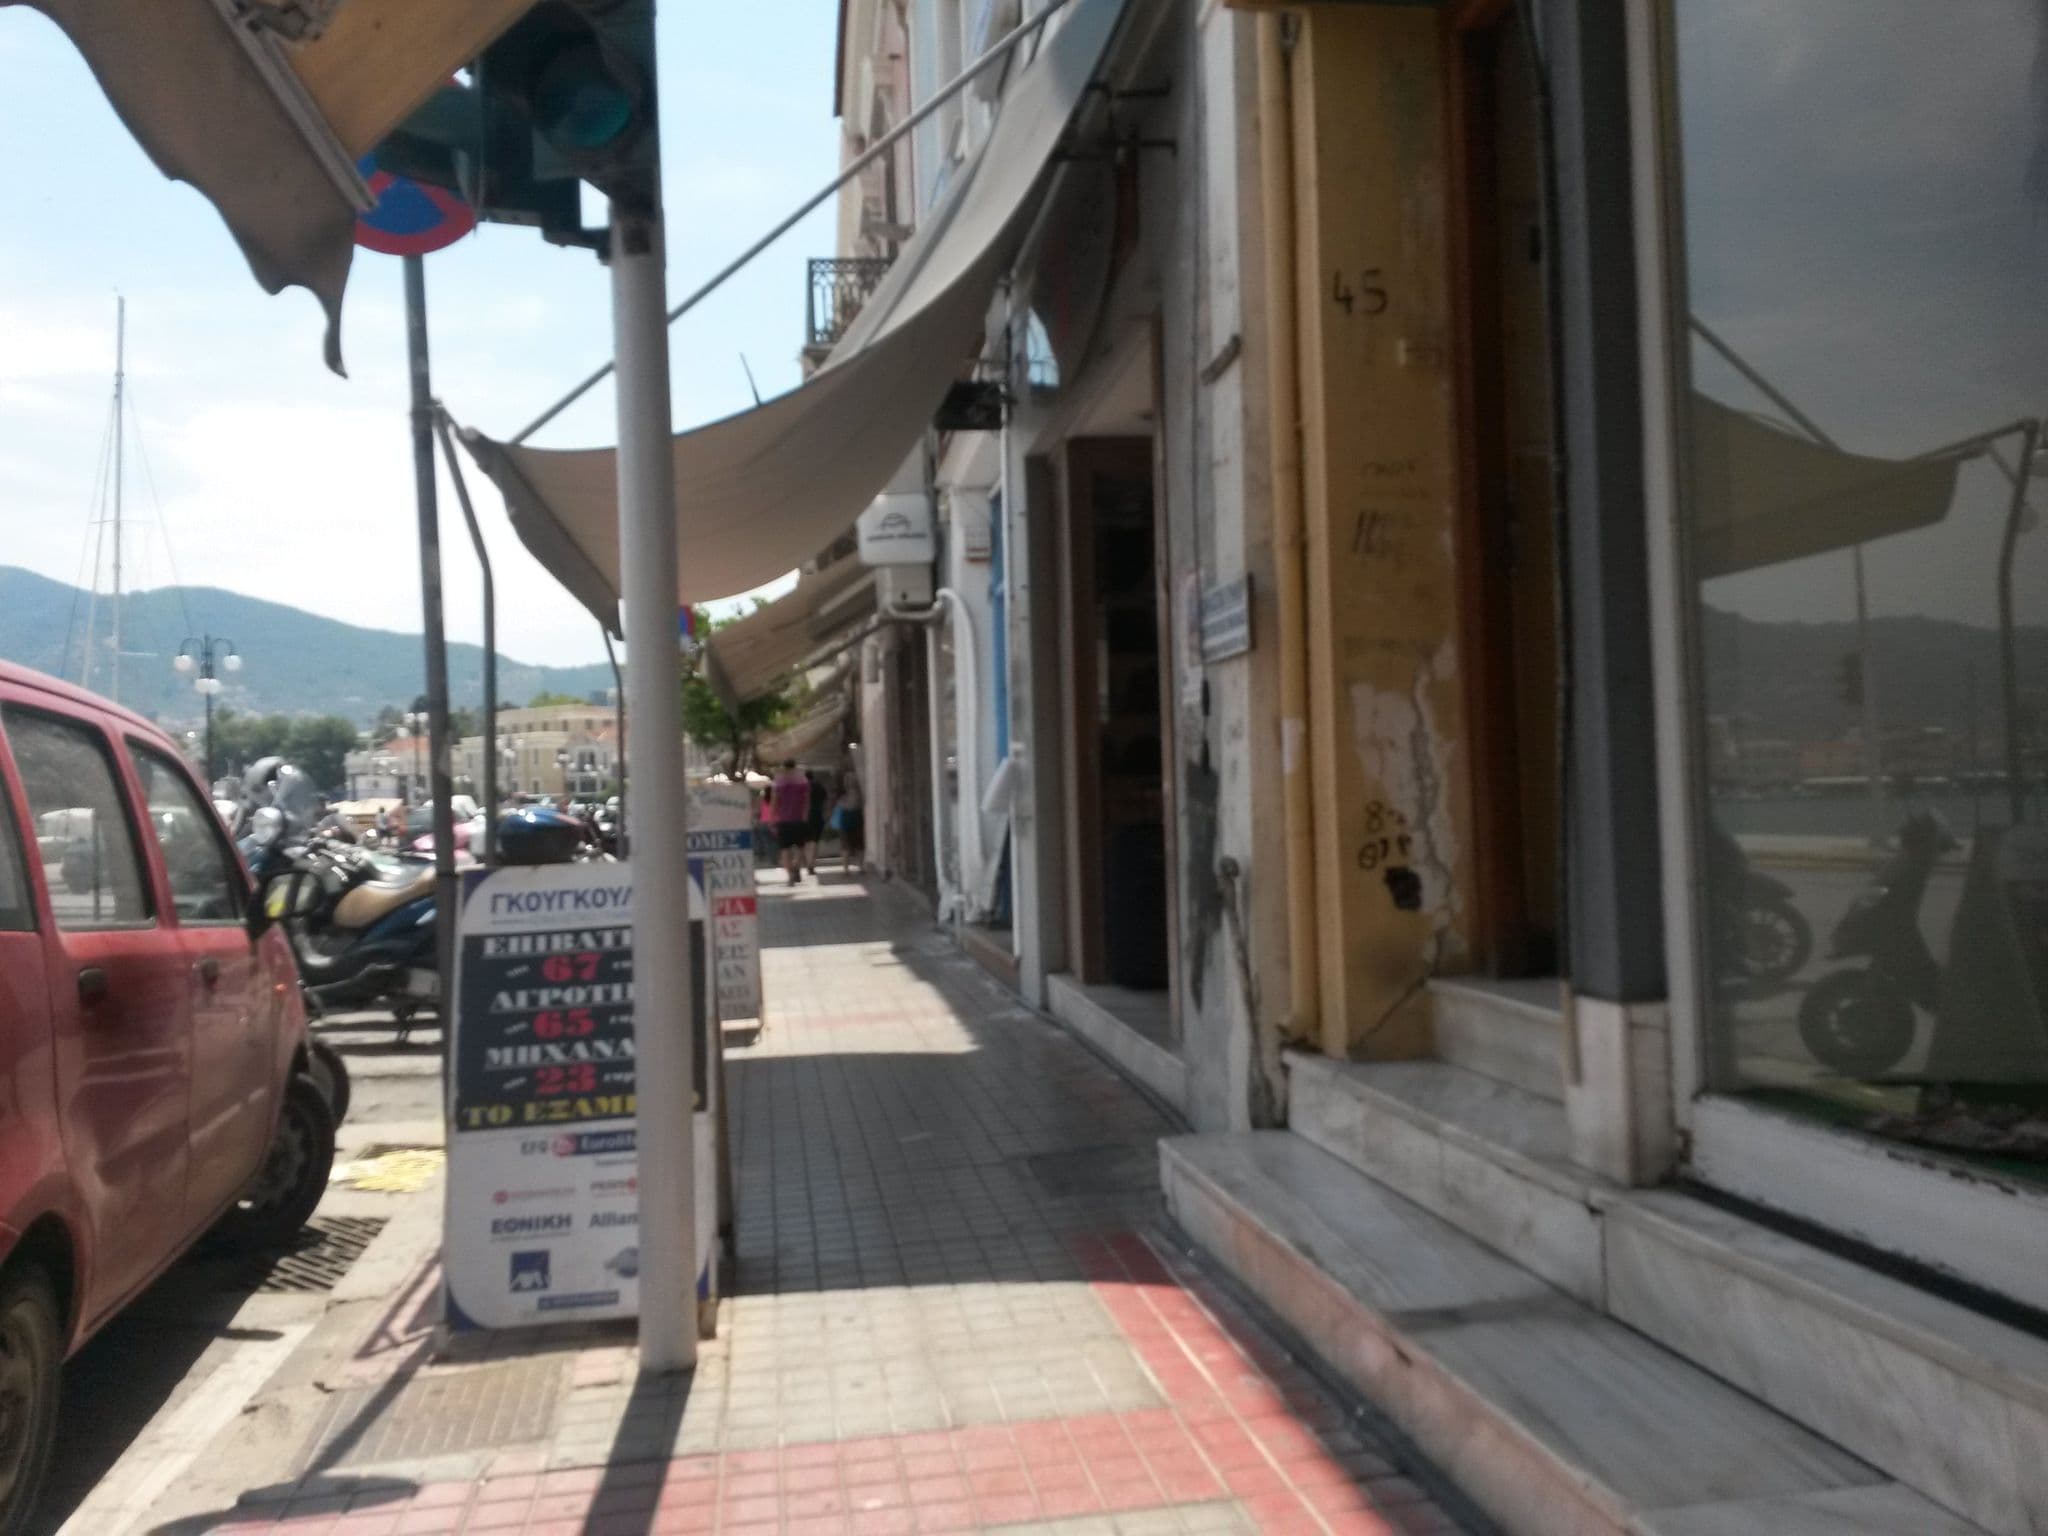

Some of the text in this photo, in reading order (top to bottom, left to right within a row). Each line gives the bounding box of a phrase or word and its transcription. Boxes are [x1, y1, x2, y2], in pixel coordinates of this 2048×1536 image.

[1333, 268, 1389, 317] 45
[542, 952, 601, 981] 67
[533, 1009, 594, 1038] 65
[535, 1064, 596, 1094] 23
[463, 1104, 512, 1127] ΤΟ
